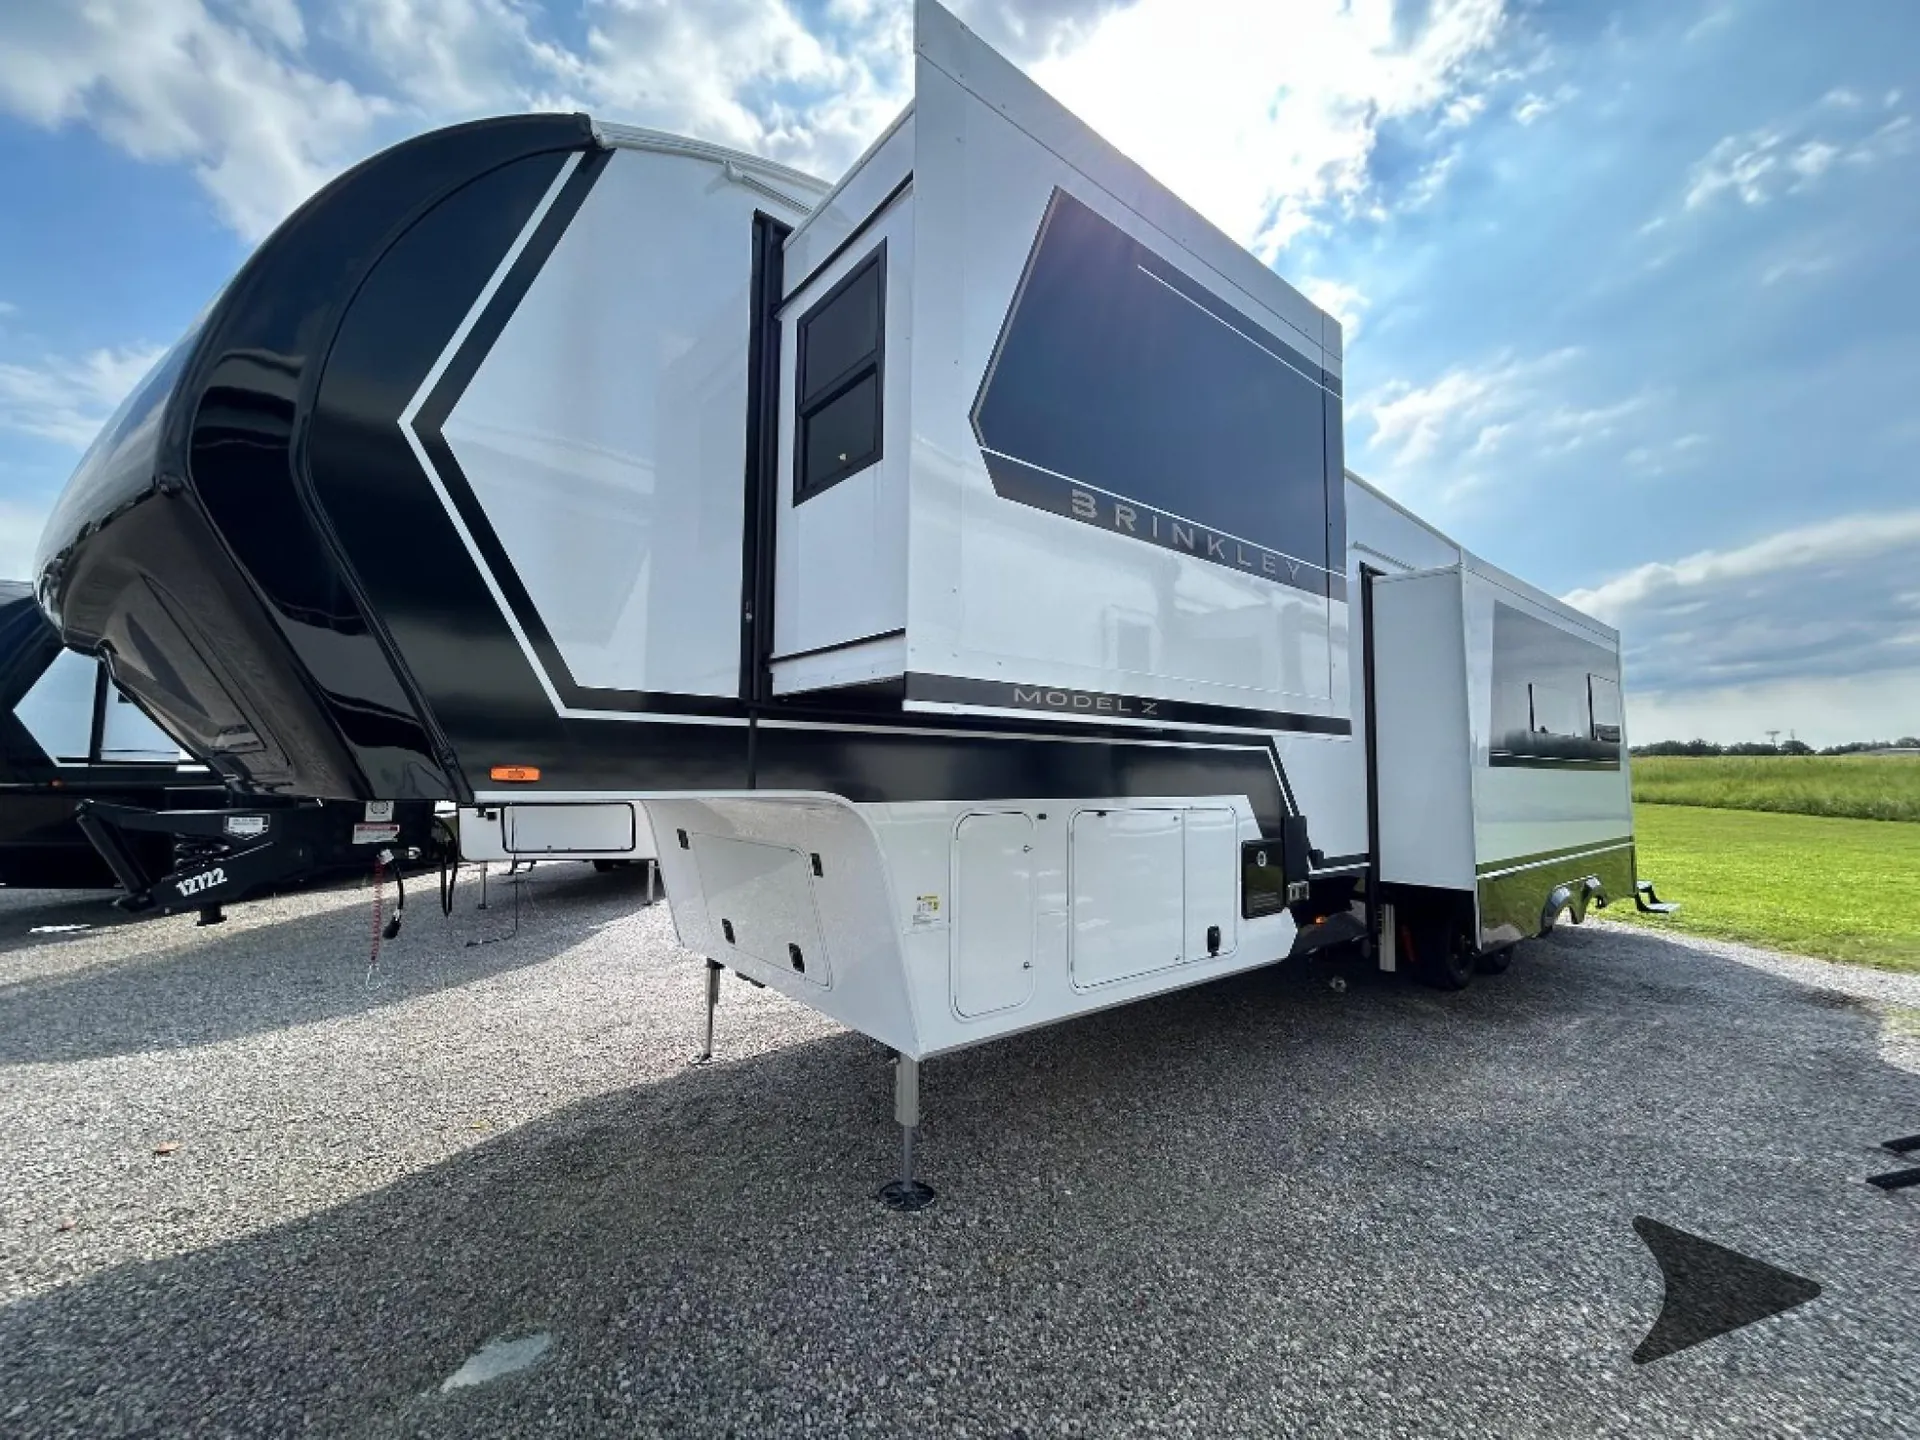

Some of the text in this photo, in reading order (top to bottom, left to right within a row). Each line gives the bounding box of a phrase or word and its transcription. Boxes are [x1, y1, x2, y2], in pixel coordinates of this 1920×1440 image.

[1071, 488, 1300, 581] BRINKLEY
[1013, 687, 1158, 715] MODEL Z
